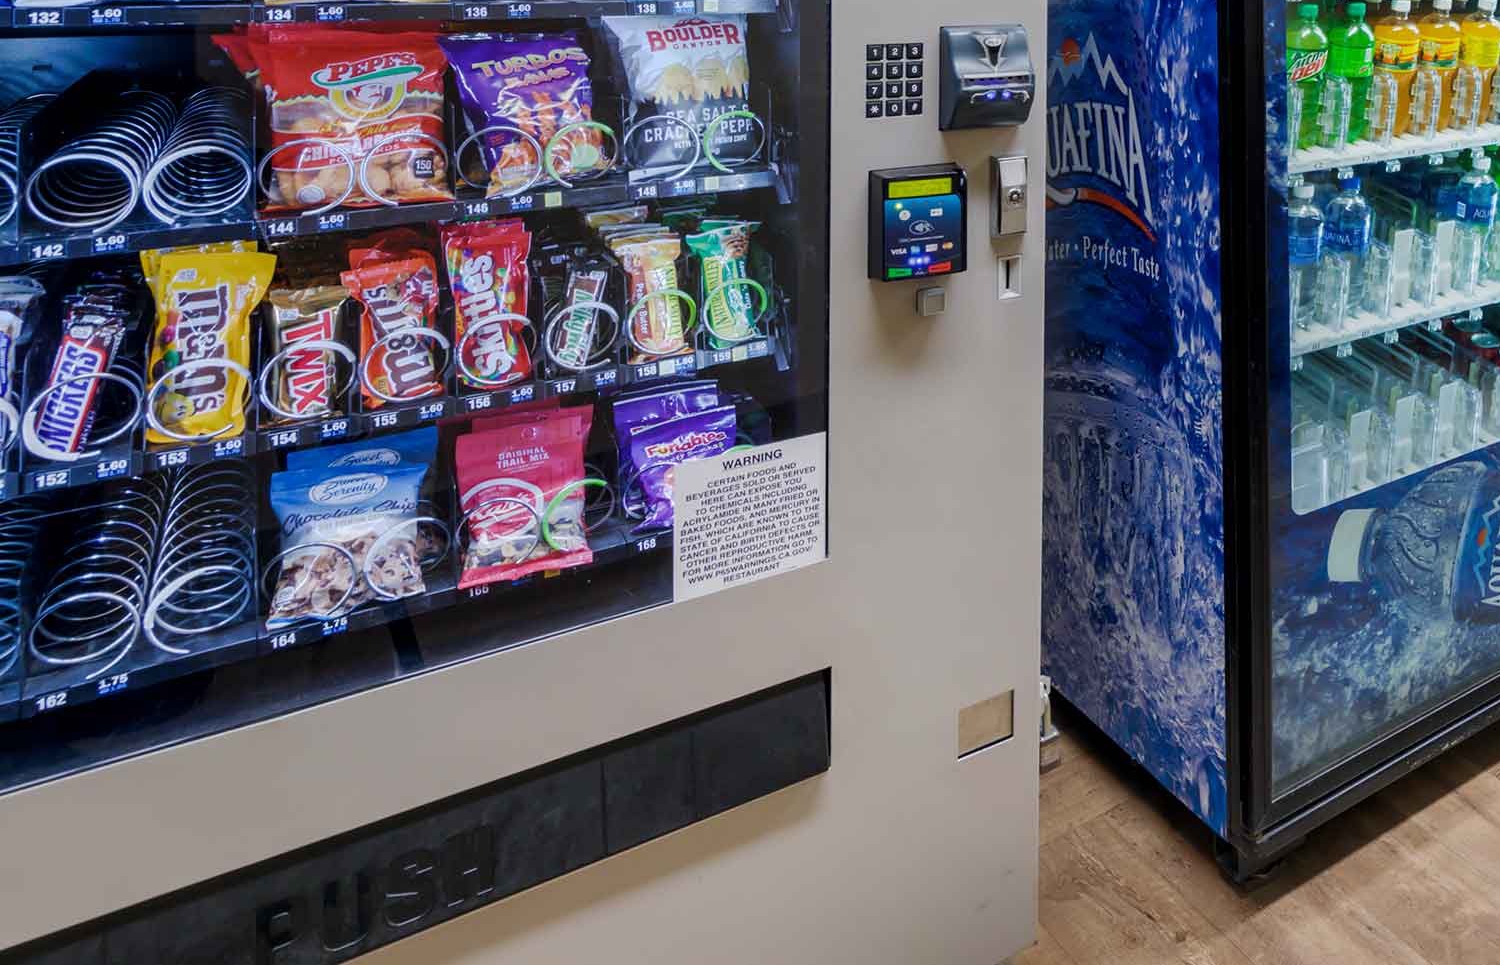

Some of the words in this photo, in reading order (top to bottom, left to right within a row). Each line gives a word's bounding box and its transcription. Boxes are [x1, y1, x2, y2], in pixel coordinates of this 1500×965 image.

[266, 9, 292, 20] 134
[465, 7, 487, 18] 136
[636, 3, 656, 13] 138
[29, 12, 59, 24] 132
[645, 24, 741, 52] BOULDER
[327, 54, 415, 82] PEPE'S
[472, 47, 588, 77] TURBOS
[666, 110, 696, 124] SEA
[416, 160, 432, 170] 150
[638, 186, 656, 197] 148
[466, 203, 488, 214] 146
[268, 221, 294, 233] 144
[32, 244, 63, 258] 142
[1082, 236, 1127, 269] Perfect
[1131, 247, 1160, 281] Taste
[462, 253, 512, 382] Skittles
[286, 313, 331, 413] TWIX
[637, 365, 656, 377] 158
[554, 381, 576, 393] 157
[37, 346, 98, 452] SNICKERS
[468, 397, 490, 409] 156
[373, 414, 397, 427] 155
[271, 432, 296, 444] 154
[159, 452, 187, 465] 153
[496, 457, 526, 469] TRAIL
[529, 452, 550, 462] MIX
[498, 446, 545, 460] ORIGINAL
[722, 449, 782, 470] WARNING
[35, 474, 67, 487] 152
[686, 484, 740, 501] BEVERAGES
[742, 478, 766, 488] SOLD
[782, 467, 816, 479] SERVED
[707, 474, 745, 488] CERTAIN
[747, 467, 776, 478] FOODS
[779, 462, 796, 471] AND
[700, 496, 724, 506] HERE
[728, 491, 746, 499] CAN
[748, 482, 780, 494] EXPOSE
[784, 477, 802, 486] YOU
[710, 495, 760, 512] CHEMICALS
[762, 484, 807, 499] INCLUDING
[680, 524, 712, 536] BAKED
[750, 510, 767, 519] AND
[769, 499, 809, 513] MERCURY
[682, 508, 740, 527] ACRYLAMIDE
[754, 499, 778, 509] MANY
[780, 492, 804, 503] FRIED
[283, 507, 368, 536] Chocolate
[706, 526, 734, 538] WHICH
[737, 521, 752, 530] ARE
[756, 512, 788, 525] KNOWN
[805, 504, 820, 512] THE
[680, 541, 708, 553] STATE
[725, 523, 776, 541] CALIFORNIA
[792, 512, 820, 524] CAUSE
[680, 547, 718, 561] CANCER
[720, 542, 738, 551] AND
[740, 534, 766, 545] BIRTH
[768, 523, 806, 538] DEFECTS
[637, 539, 656, 551] 168
[686, 555, 717, 568] OTHER
[720, 537, 785, 559] REPRODUCTIVE
[682, 568, 701, 577] FOR
[704, 560, 728, 571] MORE
[732, 544, 790, 564] INFORMATION
[723, 562, 780, 584] RESTAURANT
[271, 635, 296, 647] 164
[36, 693, 66, 707] 162
[256, 824, 496, 954] PUSH
